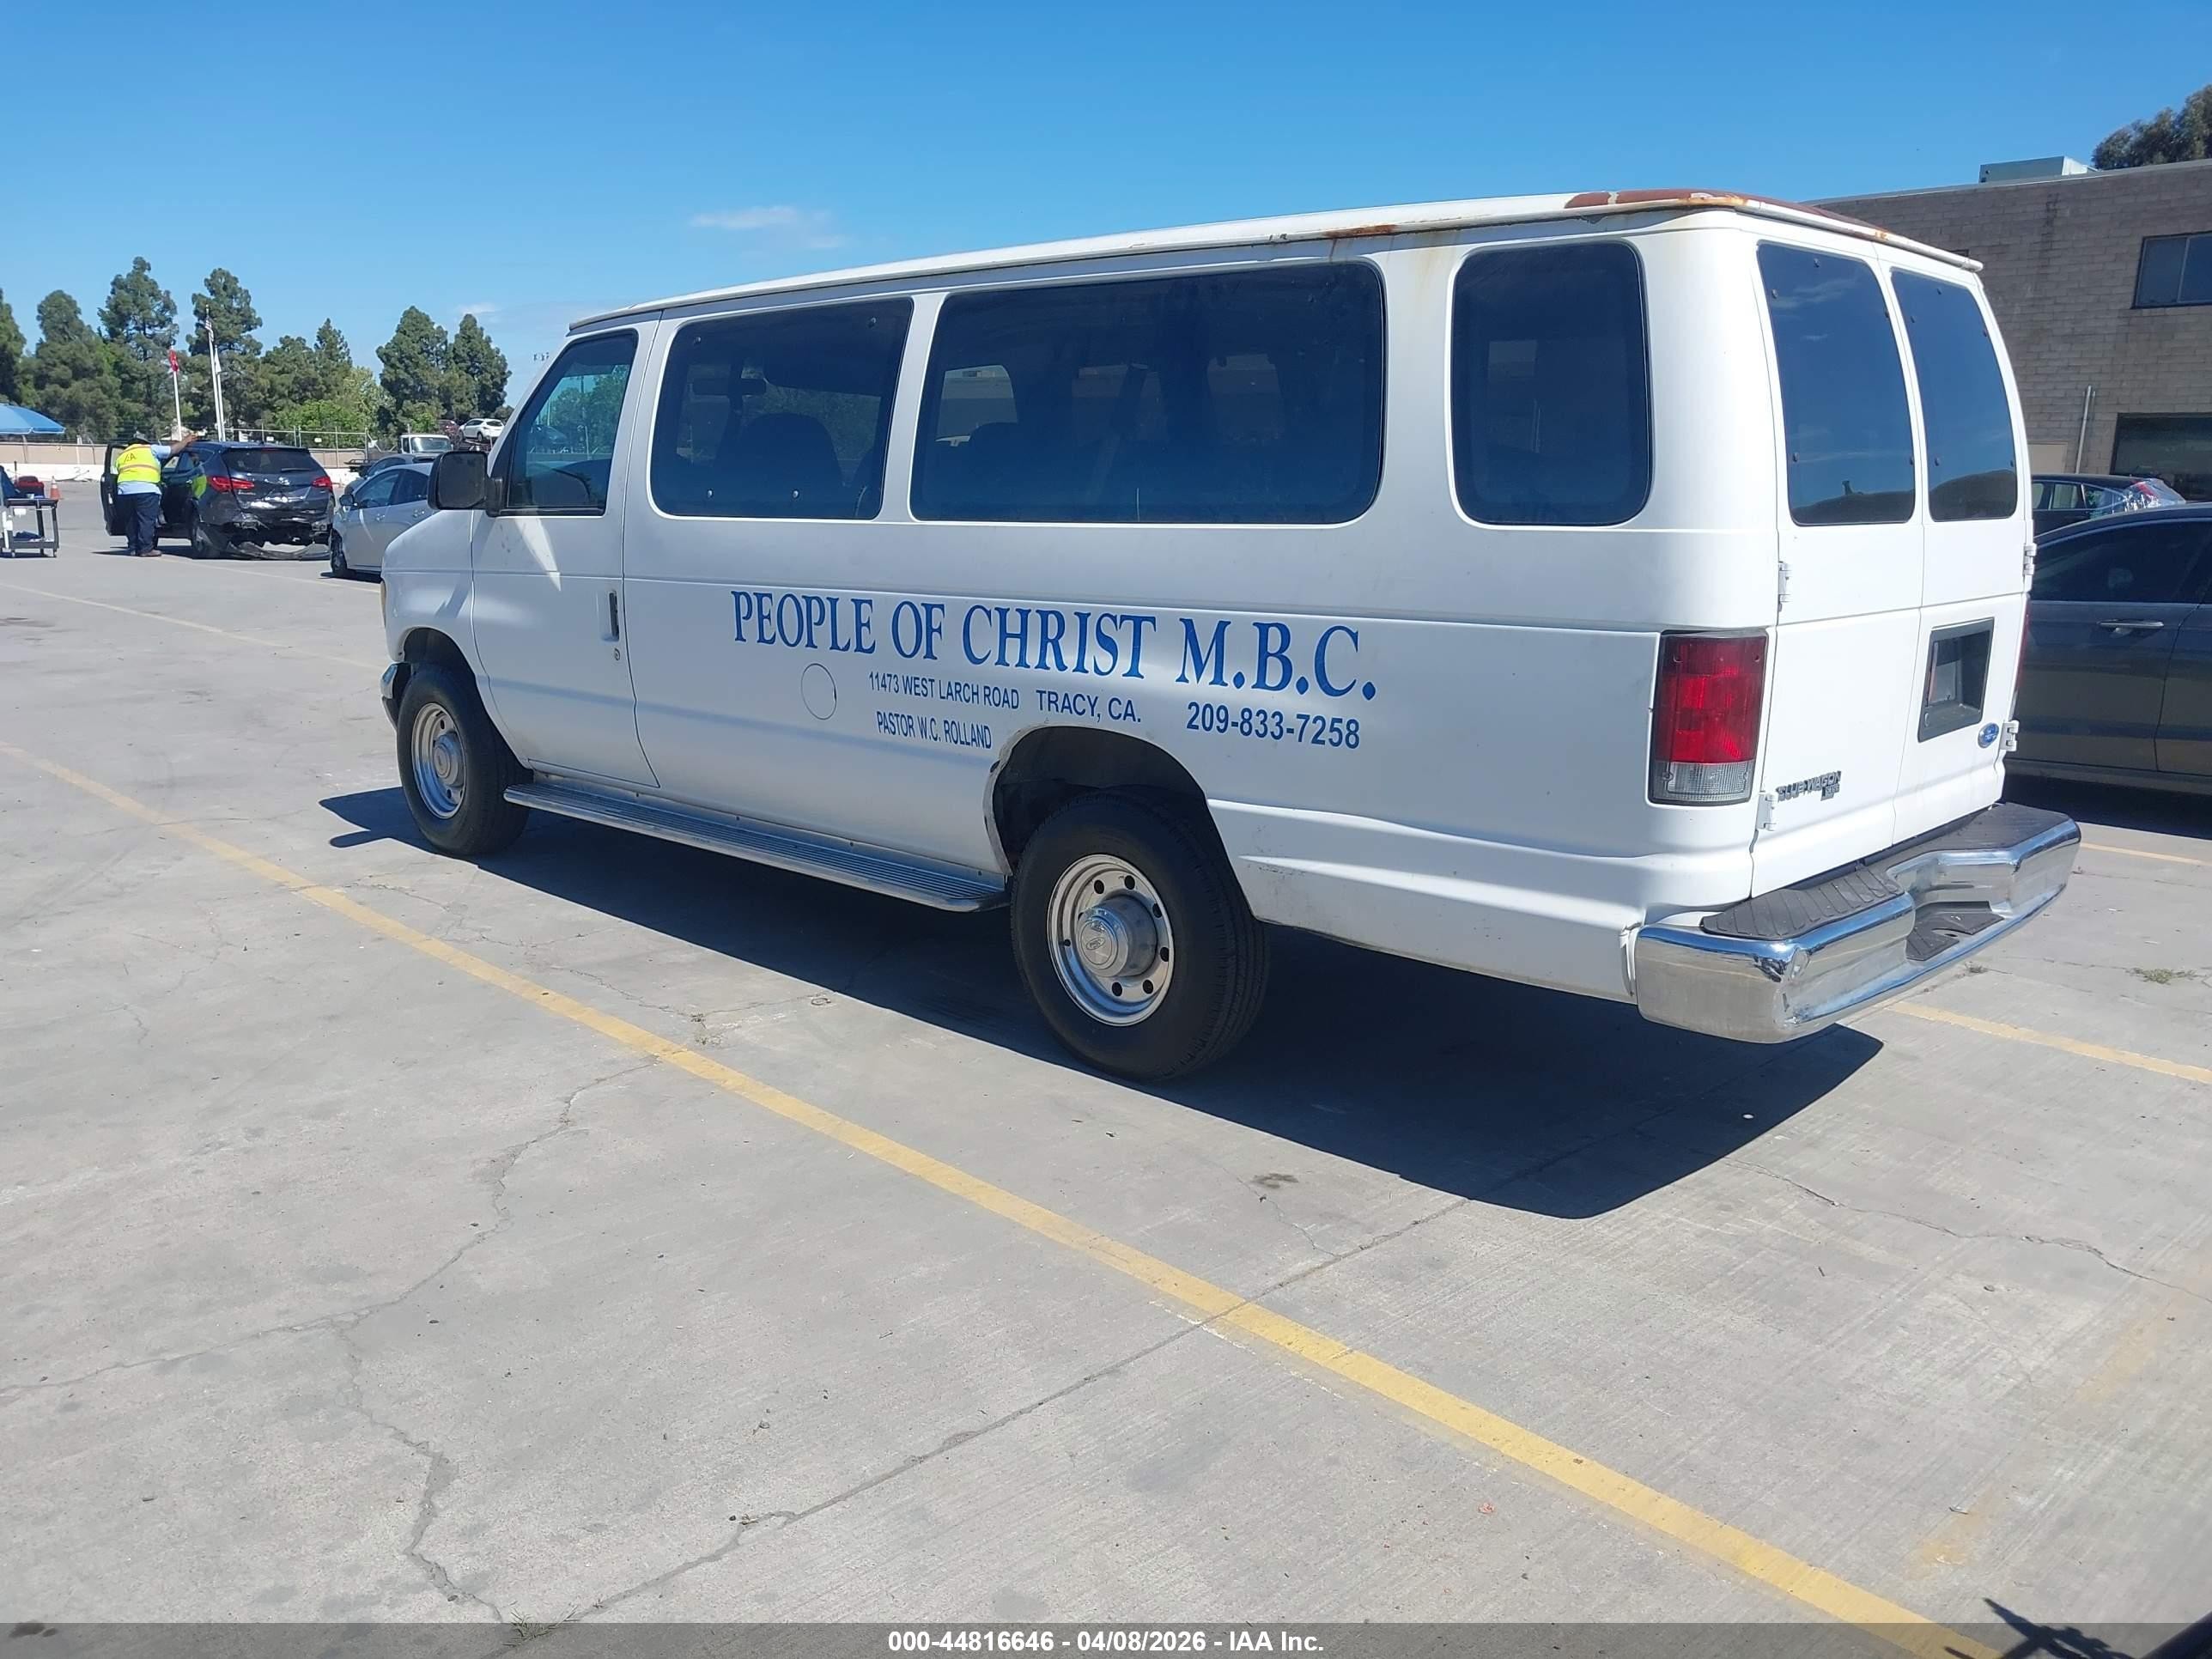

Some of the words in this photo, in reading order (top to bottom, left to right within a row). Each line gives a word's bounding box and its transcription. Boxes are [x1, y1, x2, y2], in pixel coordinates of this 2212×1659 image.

[731, 589, 877, 655] PEOPLE
[890, 600, 946, 661] OF
[961, 604, 1157, 679] CHRIST
[1176, 617, 1377, 701] M.B.C.
[868, 671, 900, 694] 11473
[902, 674, 936, 698] WEST
[939, 679, 980, 705] LARCH
[983, 685, 1020, 710] ROAD
[1035, 689, 1102, 721] TRACY,
[1108, 696, 1142, 723] CA.
[876, 710, 916, 738] PASTOR
[916, 715, 942, 742] W.C.
[943, 720, 993, 750] ROLLAND
[1186, 701, 1360, 750] 209-833-7258
